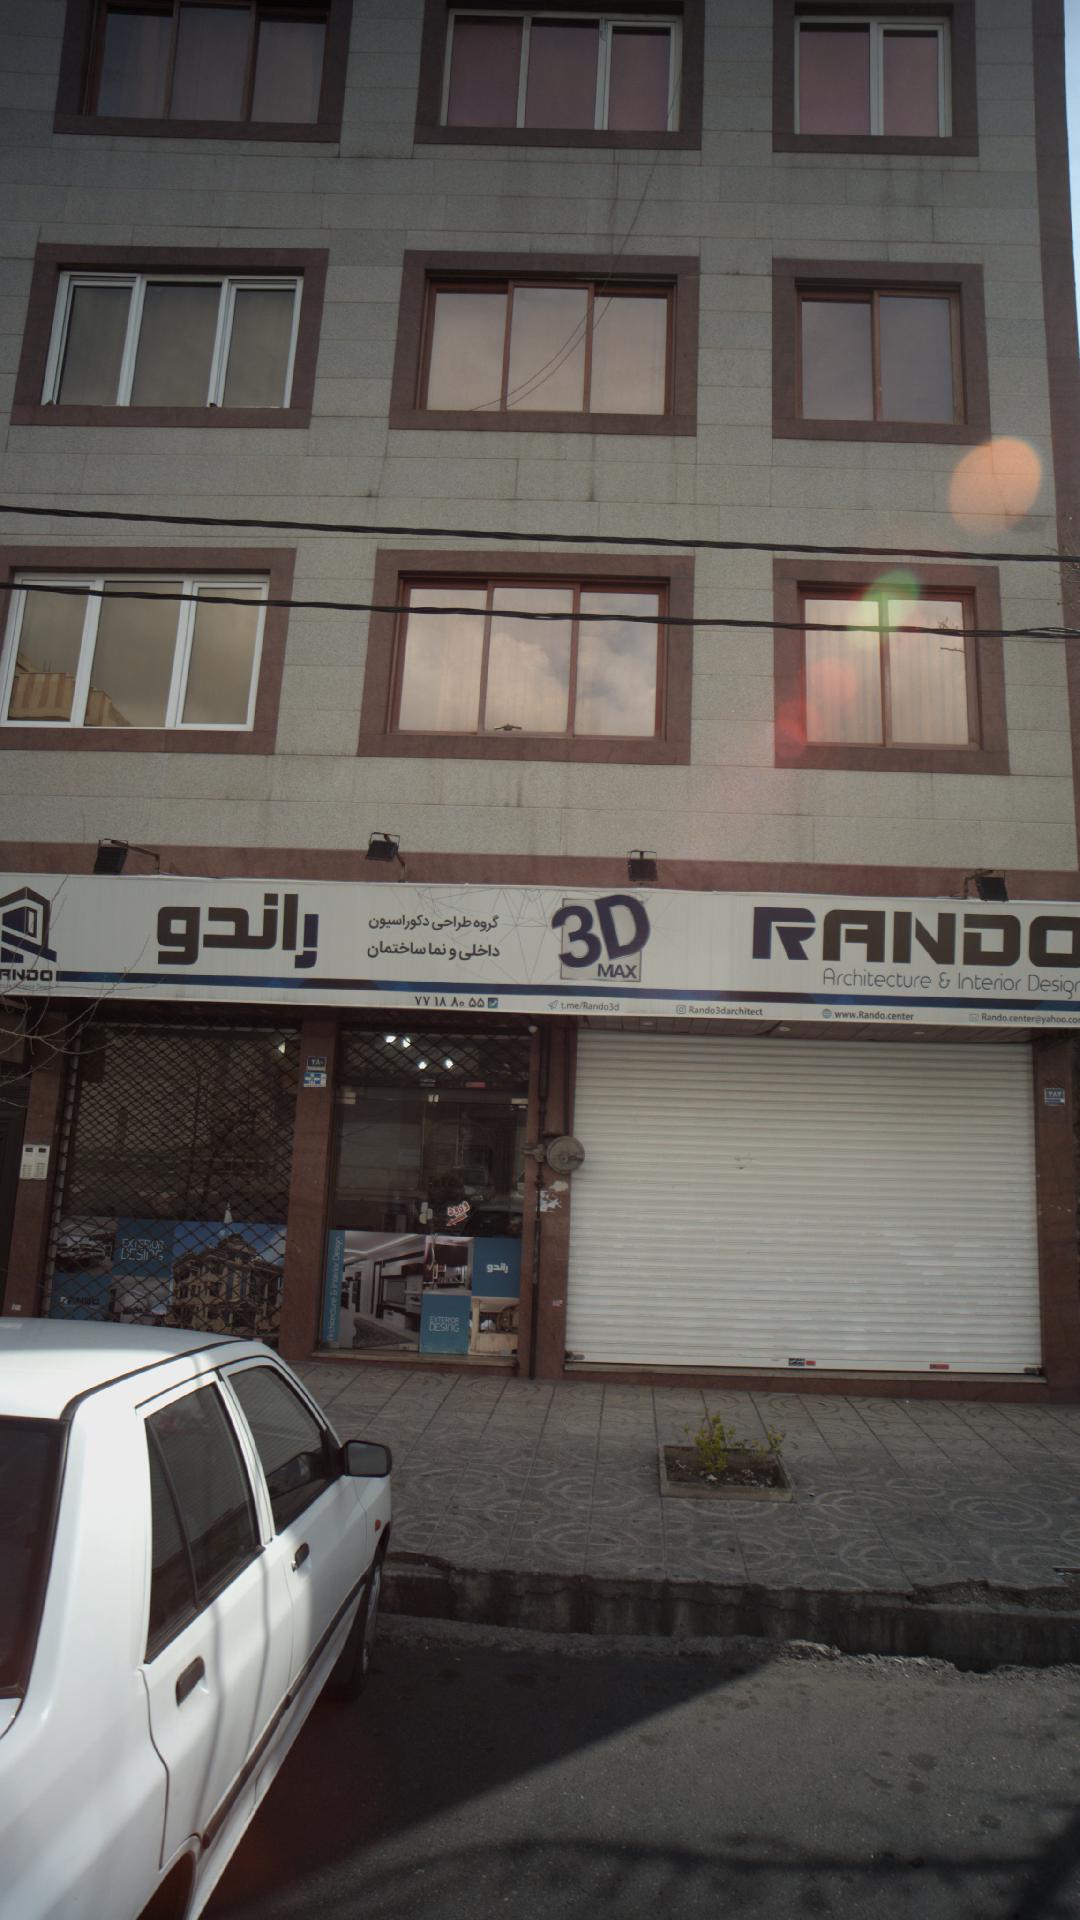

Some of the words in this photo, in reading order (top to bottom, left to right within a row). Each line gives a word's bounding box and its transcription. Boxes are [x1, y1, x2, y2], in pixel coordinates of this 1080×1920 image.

[368, 914, 430, 930] دکوراسیون
[432, 916, 472, 931] طراحی
[473, 914, 499, 932] گروه
[157, 893, 319, 968] راندو
[551, 894, 650, 968] 3D
[752, 906, 1080, 968] RANDO
[367, 940, 427, 958] ساختمان
[428, 942, 447, 956] نما
[448, 947, 457, 961] و
[459, 944, 500, 961] داخلی
[0, 969, 53, 981] ANDO
[597, 963, 638, 979] MAX
[823, 967, 932, 990] Architecture
[938, 971, 950, 990] &
[958, 972, 1022, 991] Interior
[561, 1001, 620, 1011] t.me/Rando3d
[688, 1005, 763, 1016] Rando3darchitect
[834, 1010, 914, 1021] www.Rando.center
[981, 1013, 1080, 1024] Rando.center@yahoo.co
